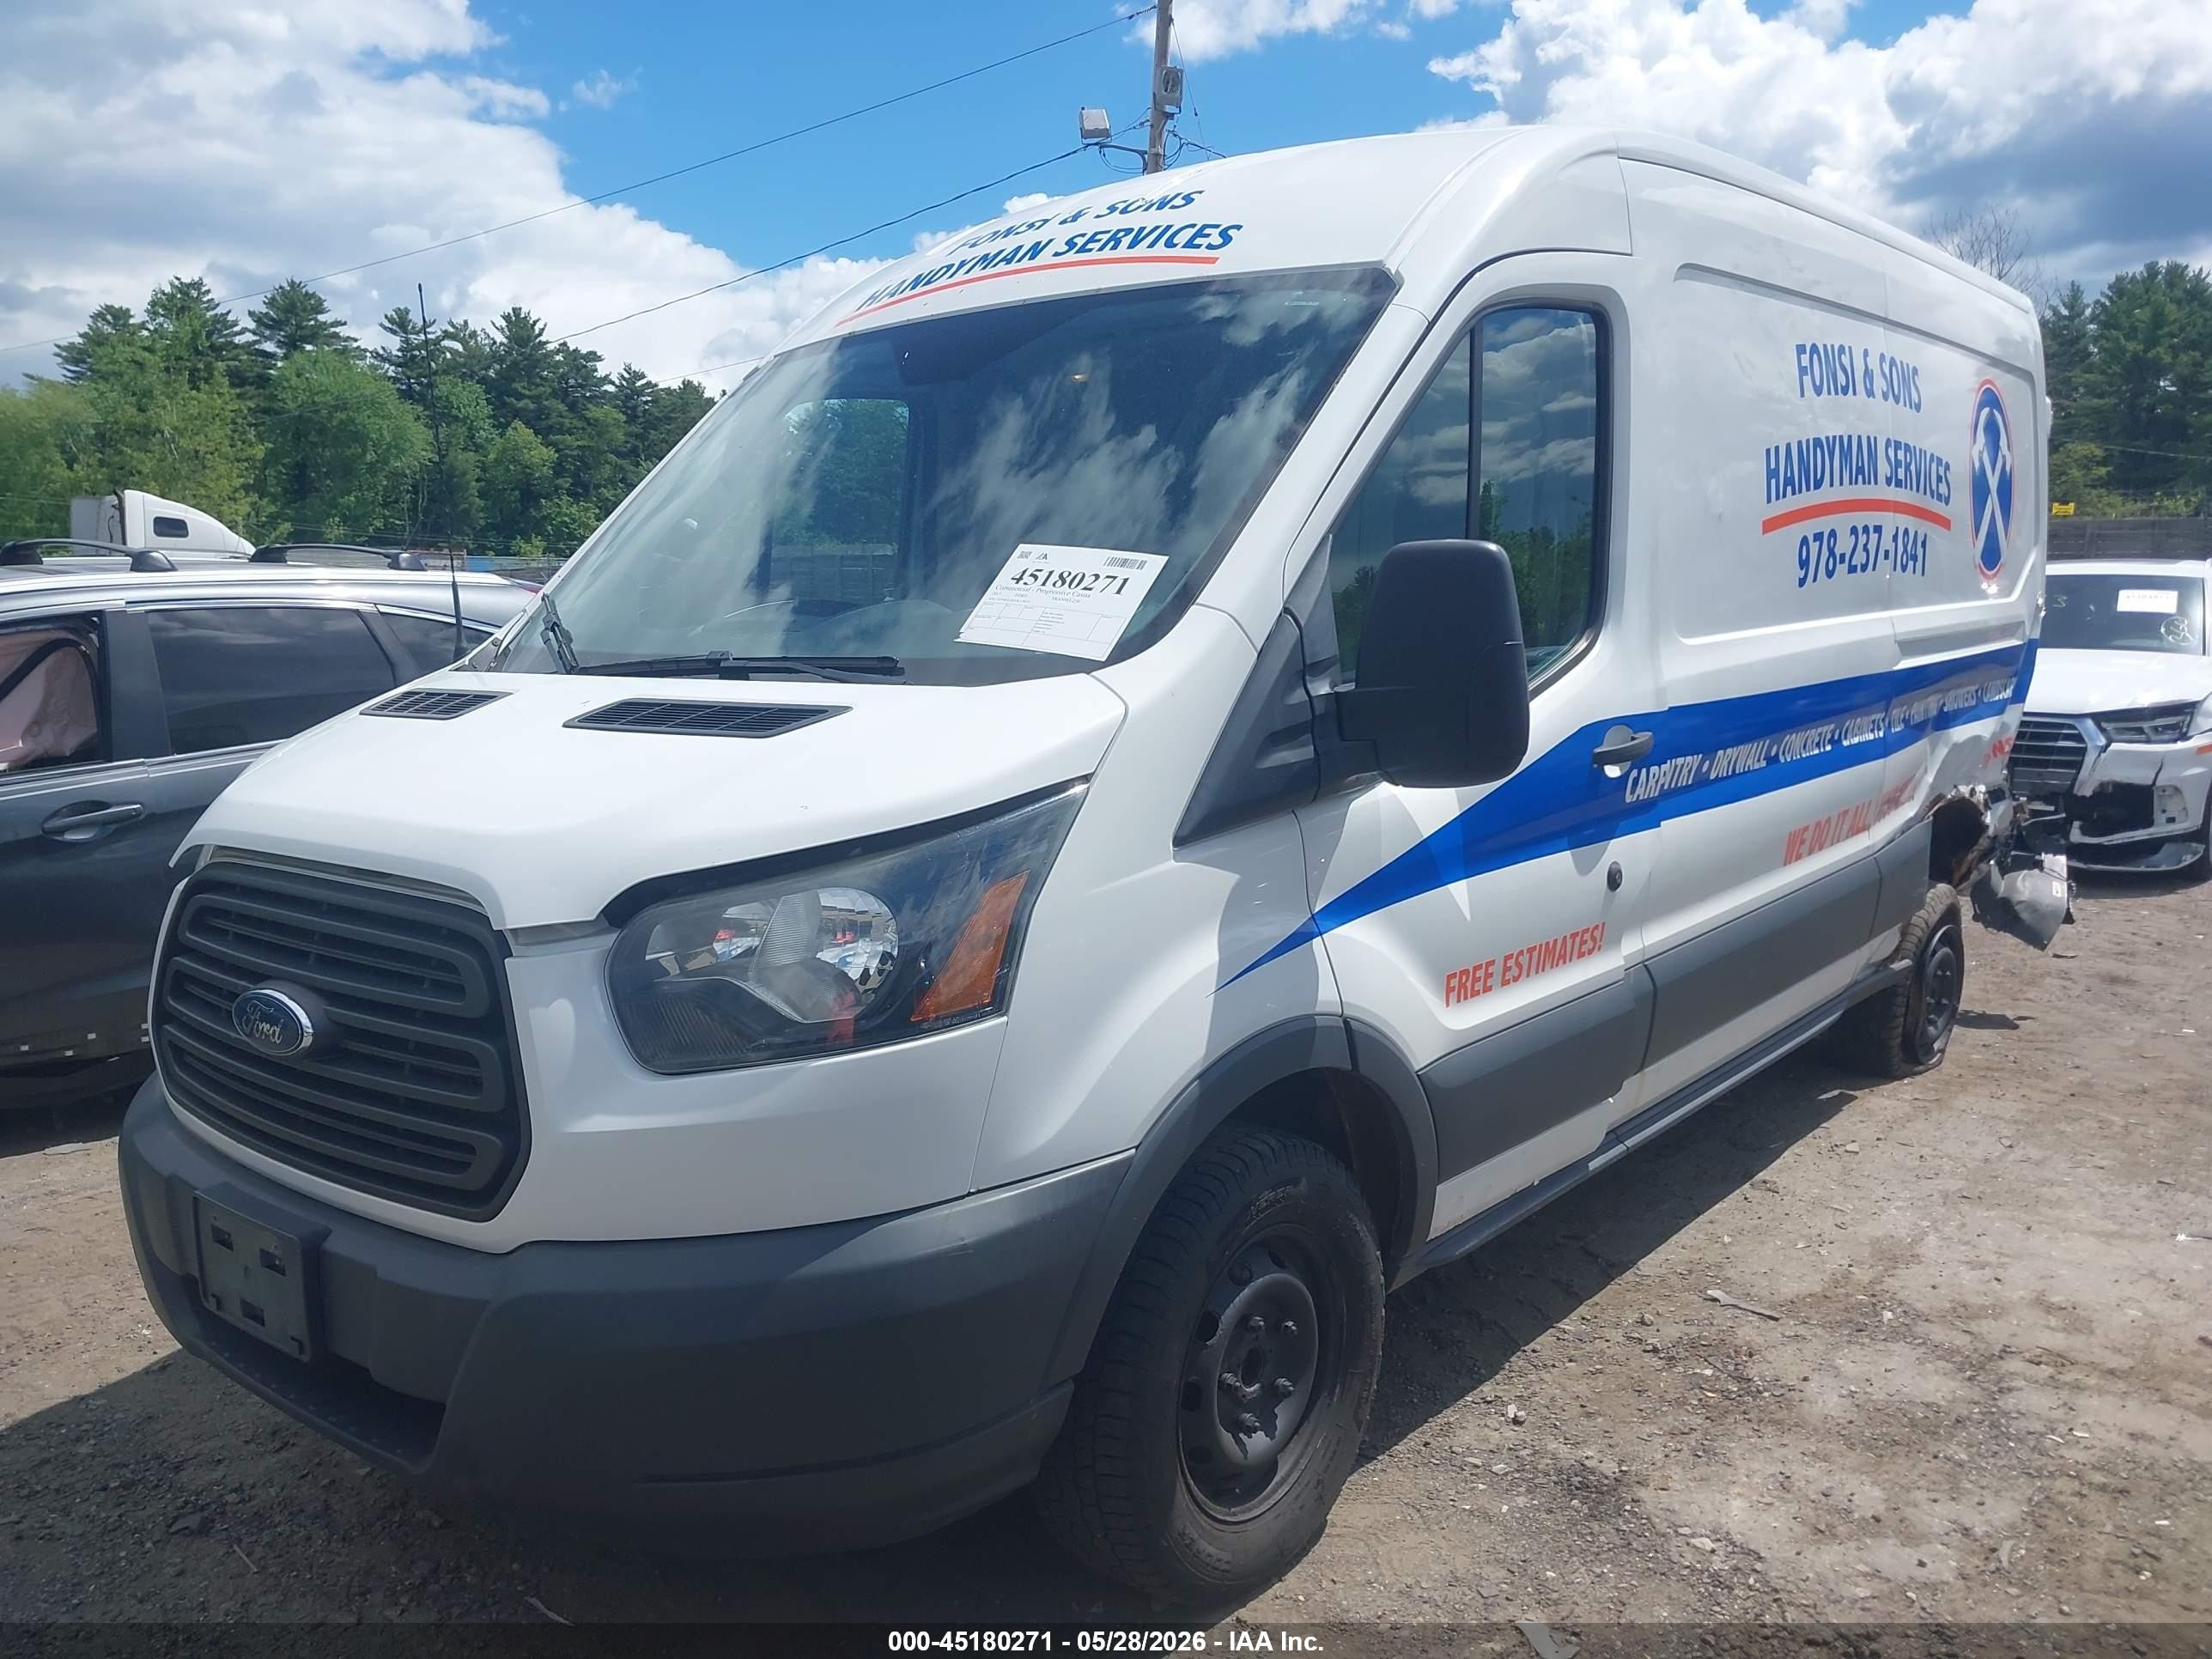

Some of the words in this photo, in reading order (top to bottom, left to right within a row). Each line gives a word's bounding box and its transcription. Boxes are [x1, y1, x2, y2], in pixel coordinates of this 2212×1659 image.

[945, 213, 1060, 258] FONSI
[1058, 206, 1093, 226] &
[1093, 190, 1206, 220] SONS
[855, 237, 1055, 312] HANDYMAN
[1052, 223, 1243, 258] SERVICES
[1795, 343, 1857, 398] FONSI
[1862, 348, 1876, 399] &
[1878, 352, 1923, 414] SONS
[1765, 434, 1879, 505] HANDYMAN
[1884, 436, 1951, 507] SERVICES
[1011, 567, 1132, 597] 45180271
[1797, 524, 1928, 589] 978-237-1841
[1710, 739, 1771, 780] DRYWALL
[1778, 724, 1835, 763] CONCRETE
[1841, 712, 1886, 747] CABINETS
[1783, 824, 1810, 866] WE
[1445, 959, 1496, 1008] FREE
[1500, 921, 1606, 988] ESTIMATES!
[242, 1000, 284, 1045] Ford
